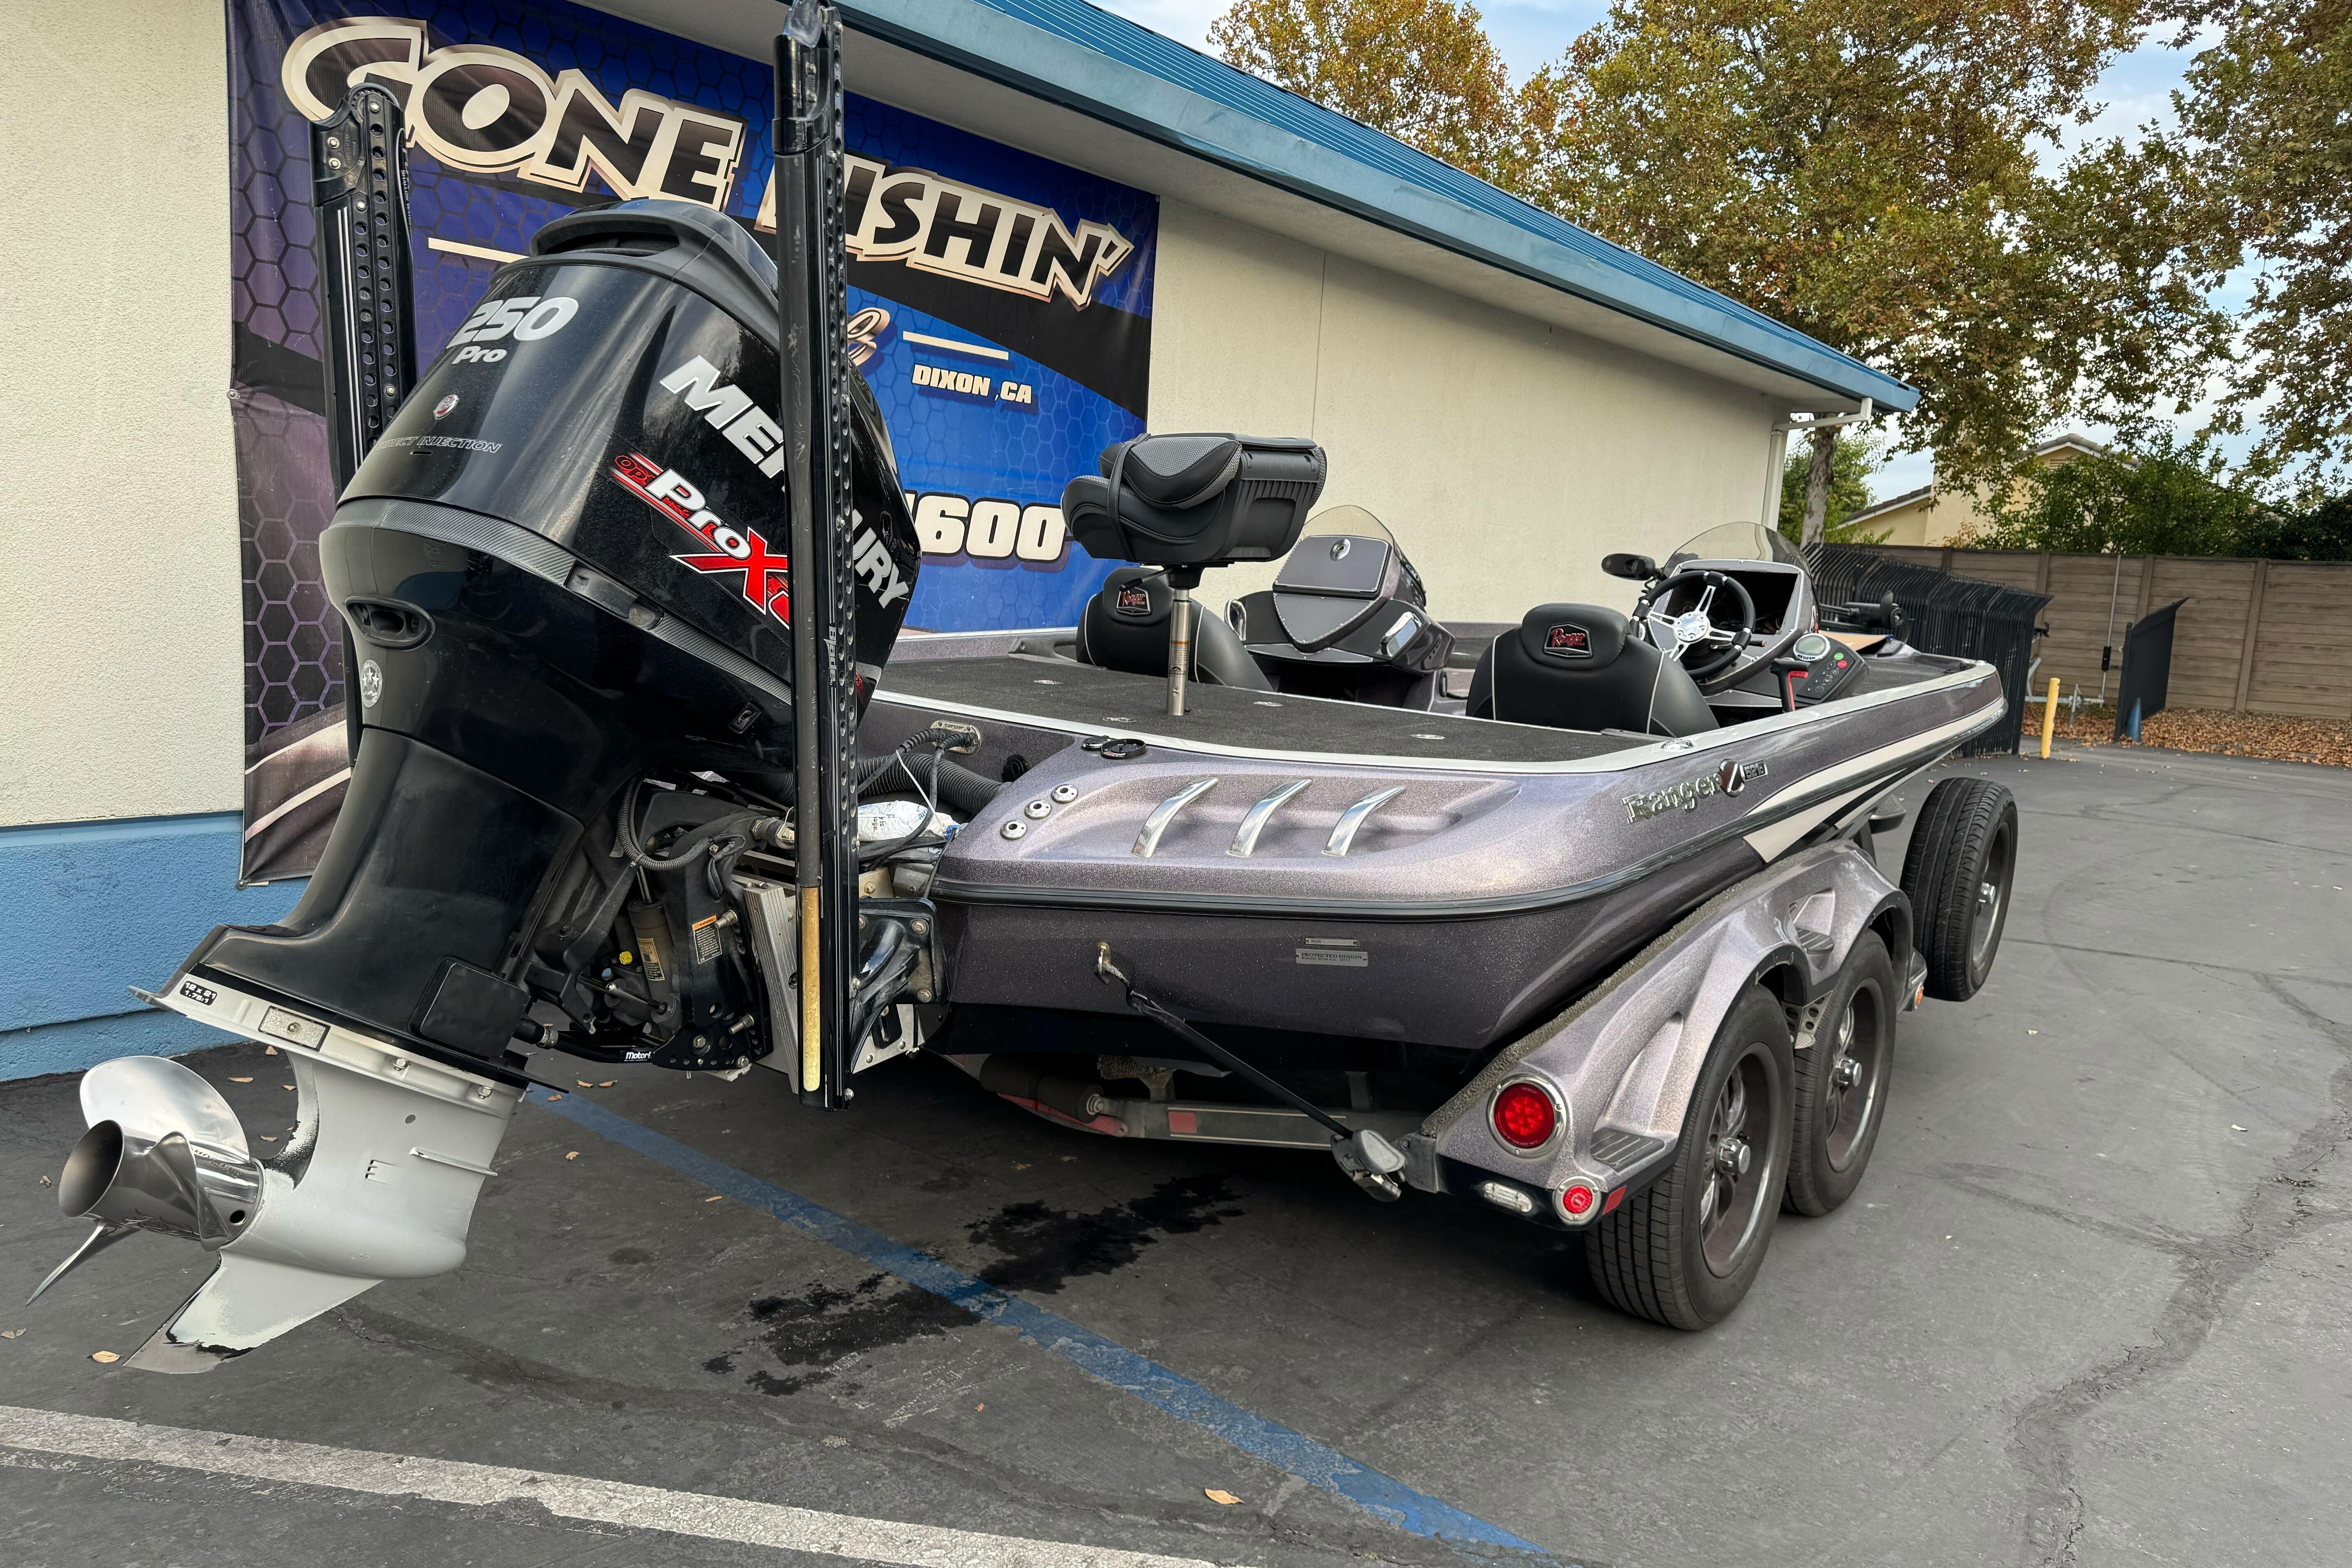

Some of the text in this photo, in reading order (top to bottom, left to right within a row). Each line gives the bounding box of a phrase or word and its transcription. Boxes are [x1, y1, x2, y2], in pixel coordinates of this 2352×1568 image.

[283, 18, 1134, 311] GONE ISHIN'
[446, 296, 579, 349] 250
[452, 346, 507, 364] Pro
[912, 364, 991, 397] DIXON
[417, 435, 502, 453] INJECTION
[660, 354, 908, 609] MEURY
[646, 467, 789, 630] ProX
[905, 490, 1067, 563] 600
[824, 626, 837, 682] Blade
[1550, 628, 1587, 648] Ranger
[1621, 772, 1723, 824] Ranger
[184, 990, 209, 1003] 1.75:1
[185, 982, 197, 991] 12
[203, 990, 217, 999] 21
